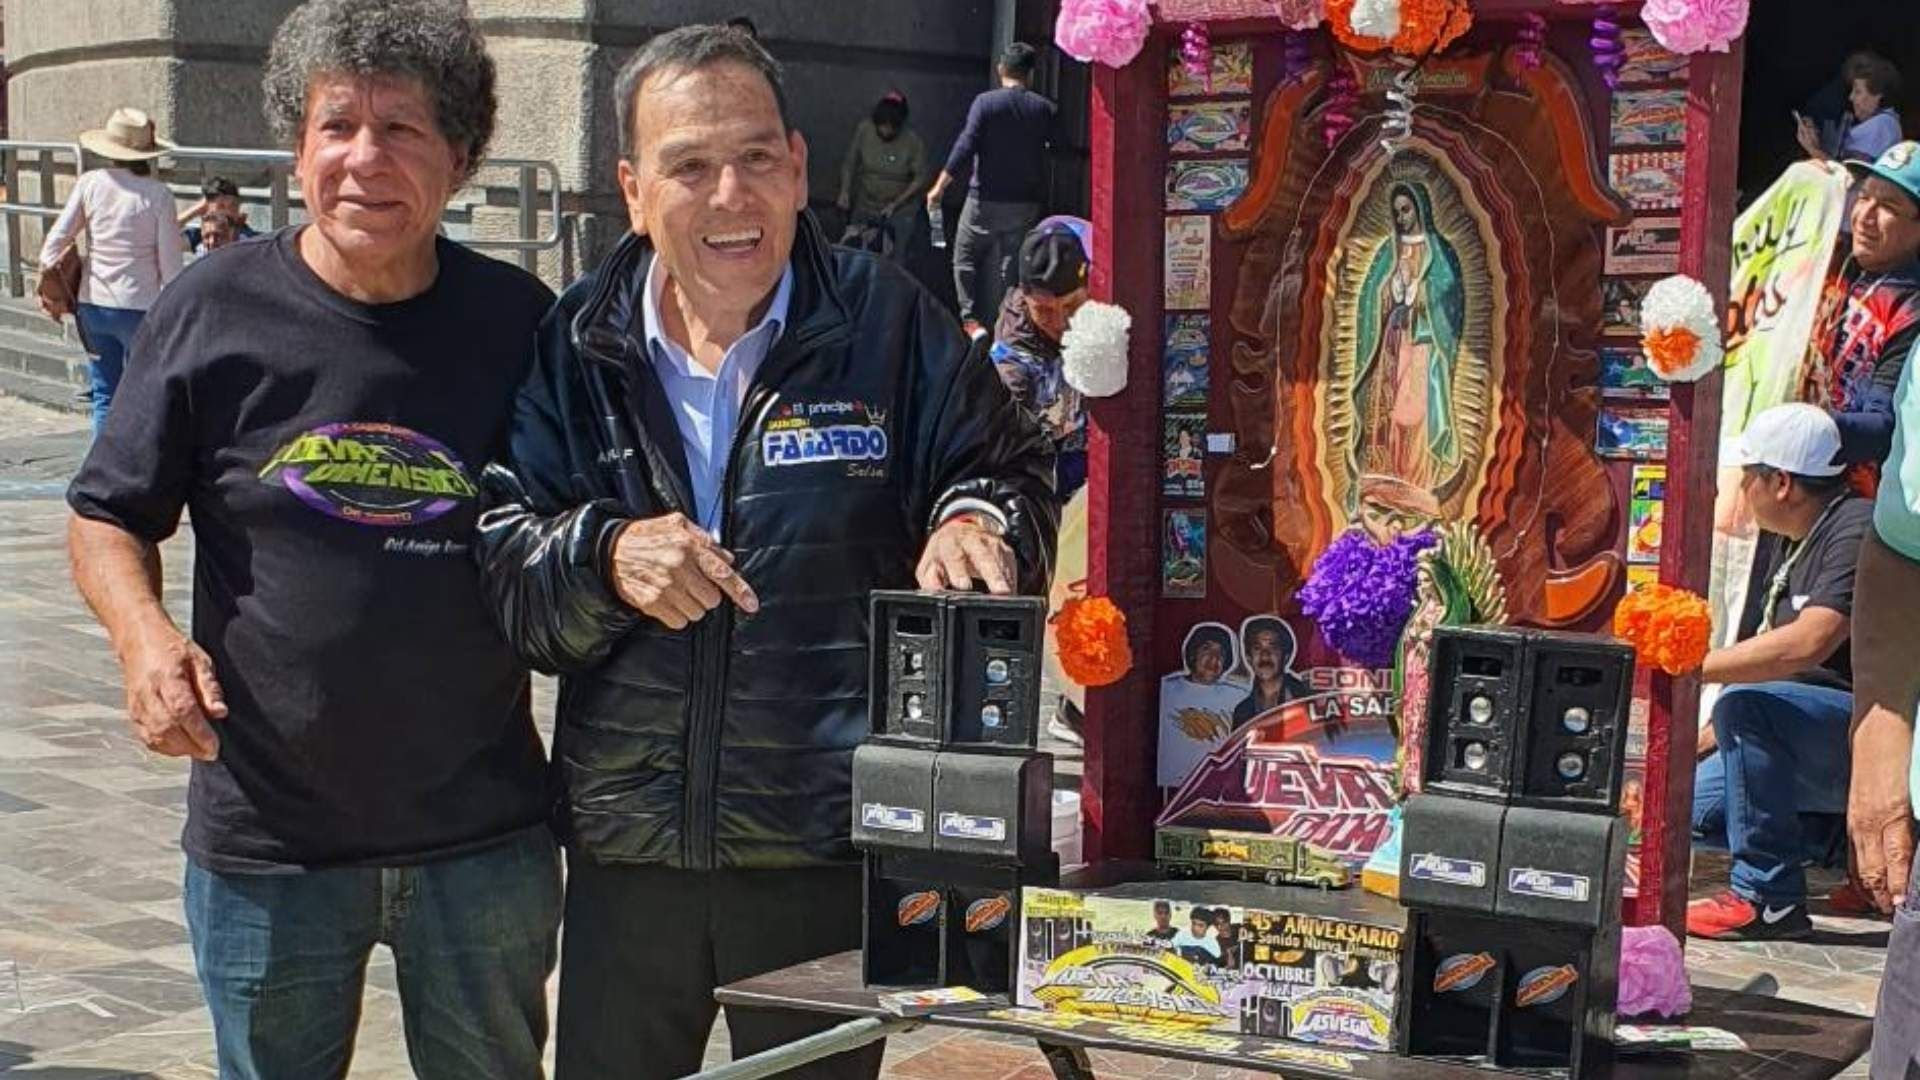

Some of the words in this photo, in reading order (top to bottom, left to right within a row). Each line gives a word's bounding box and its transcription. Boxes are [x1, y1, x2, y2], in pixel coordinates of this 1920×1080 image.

[1310, 667, 1394, 692] SONI
[1309, 698, 1342, 722] LA
[1273, 811, 1392, 856] DIM
[1258, 931, 1301, 947] Sonido
[1284, 916, 1400, 949] ANIVERSARIO
[1243, 962, 1315, 985] OCTUBRE
